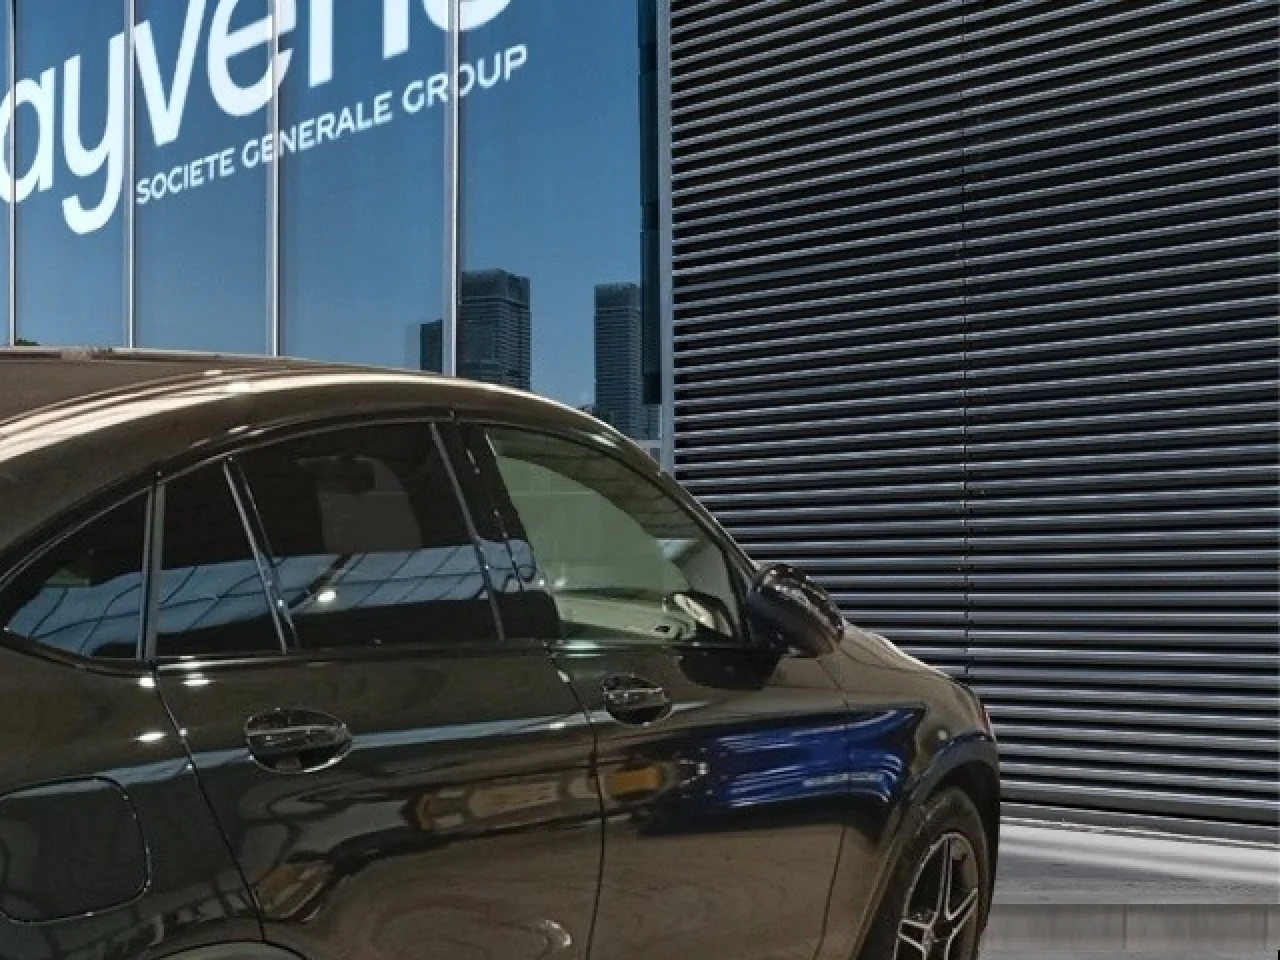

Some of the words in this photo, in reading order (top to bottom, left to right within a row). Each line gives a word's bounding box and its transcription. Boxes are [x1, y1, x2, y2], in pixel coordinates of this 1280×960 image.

[136, 148, 236, 203] SOCIETE
[241, 91, 393, 168] GENERALE
[403, 44, 528, 113] GROUP
